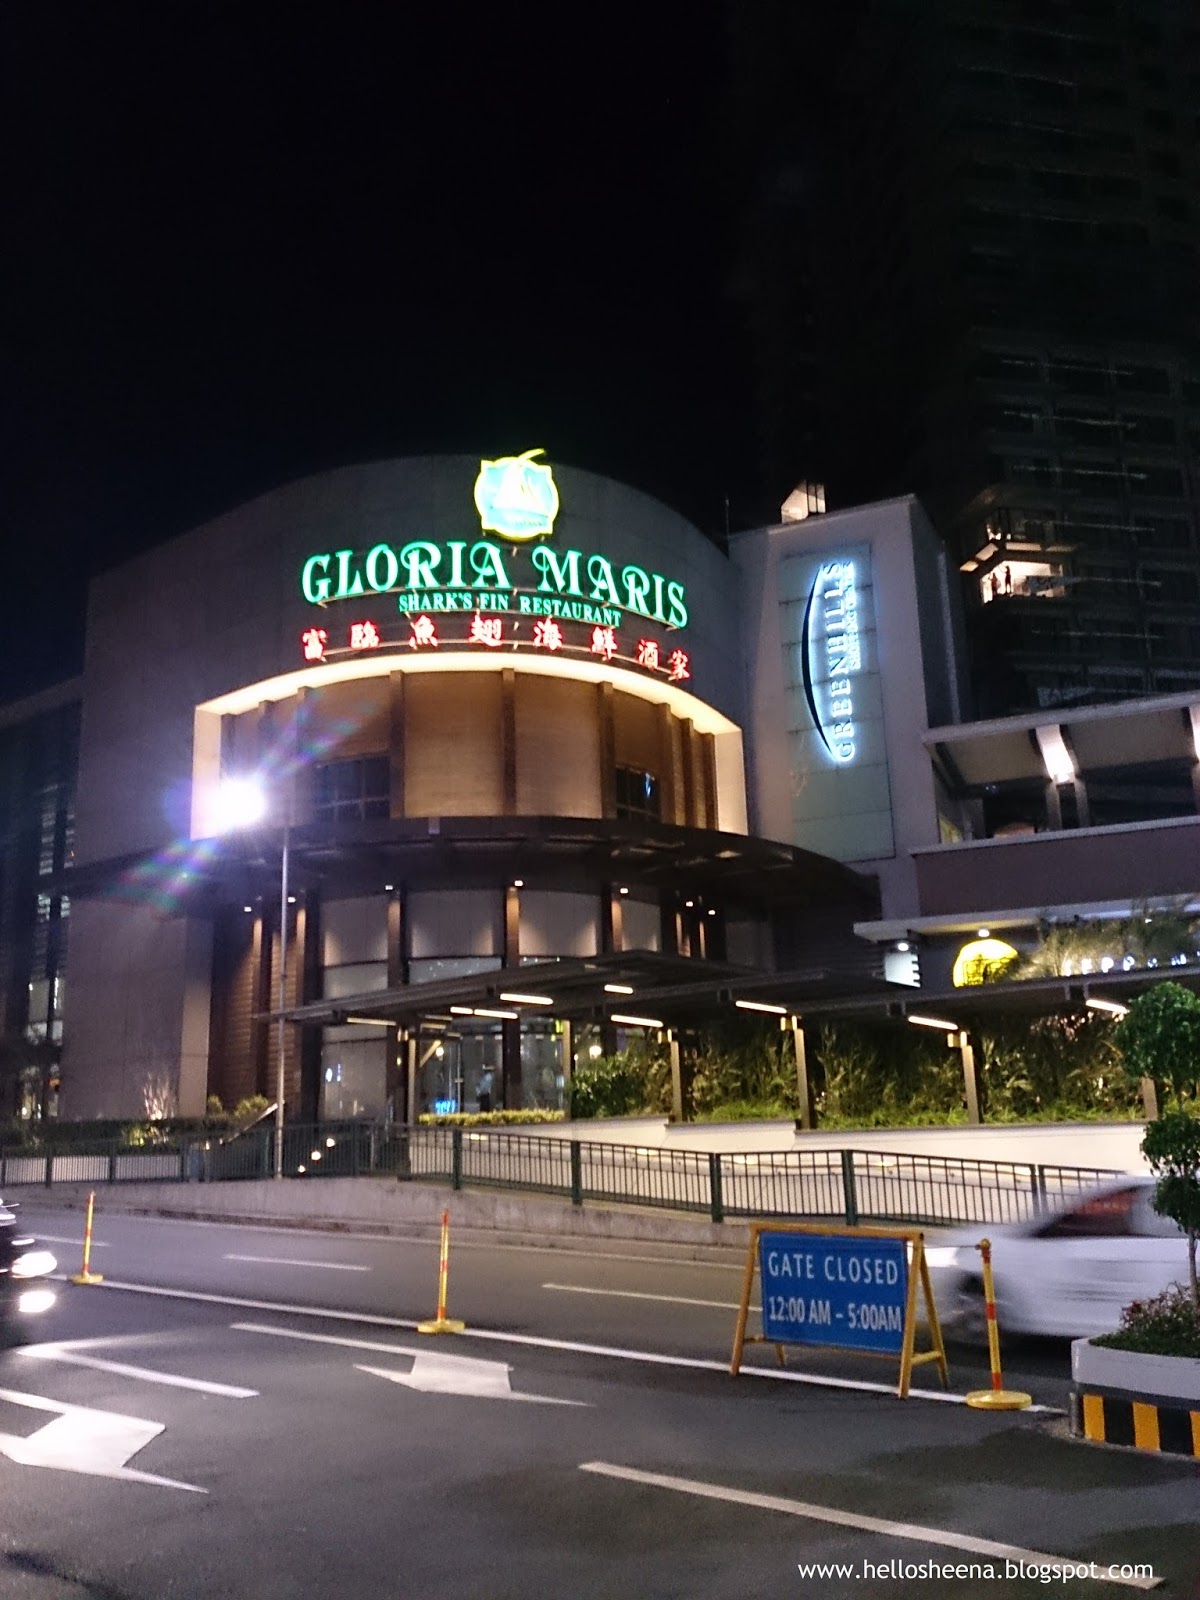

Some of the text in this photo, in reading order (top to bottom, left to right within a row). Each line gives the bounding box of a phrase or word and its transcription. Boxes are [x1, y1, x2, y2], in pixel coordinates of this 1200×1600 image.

[302, 541, 689, 628] GLORIA MARIS
[399, 592, 622, 628] SHARK'S FIN RESTAURANT
[822, 561, 856, 763] GREENHILLS
[768, 1251, 898, 1285] GATE CLOSED
[769, 1296, 804, 1324] 12:00
[808, 1299, 831, 1326] AM
[848, 1303, 902, 1333] 5:00AM
